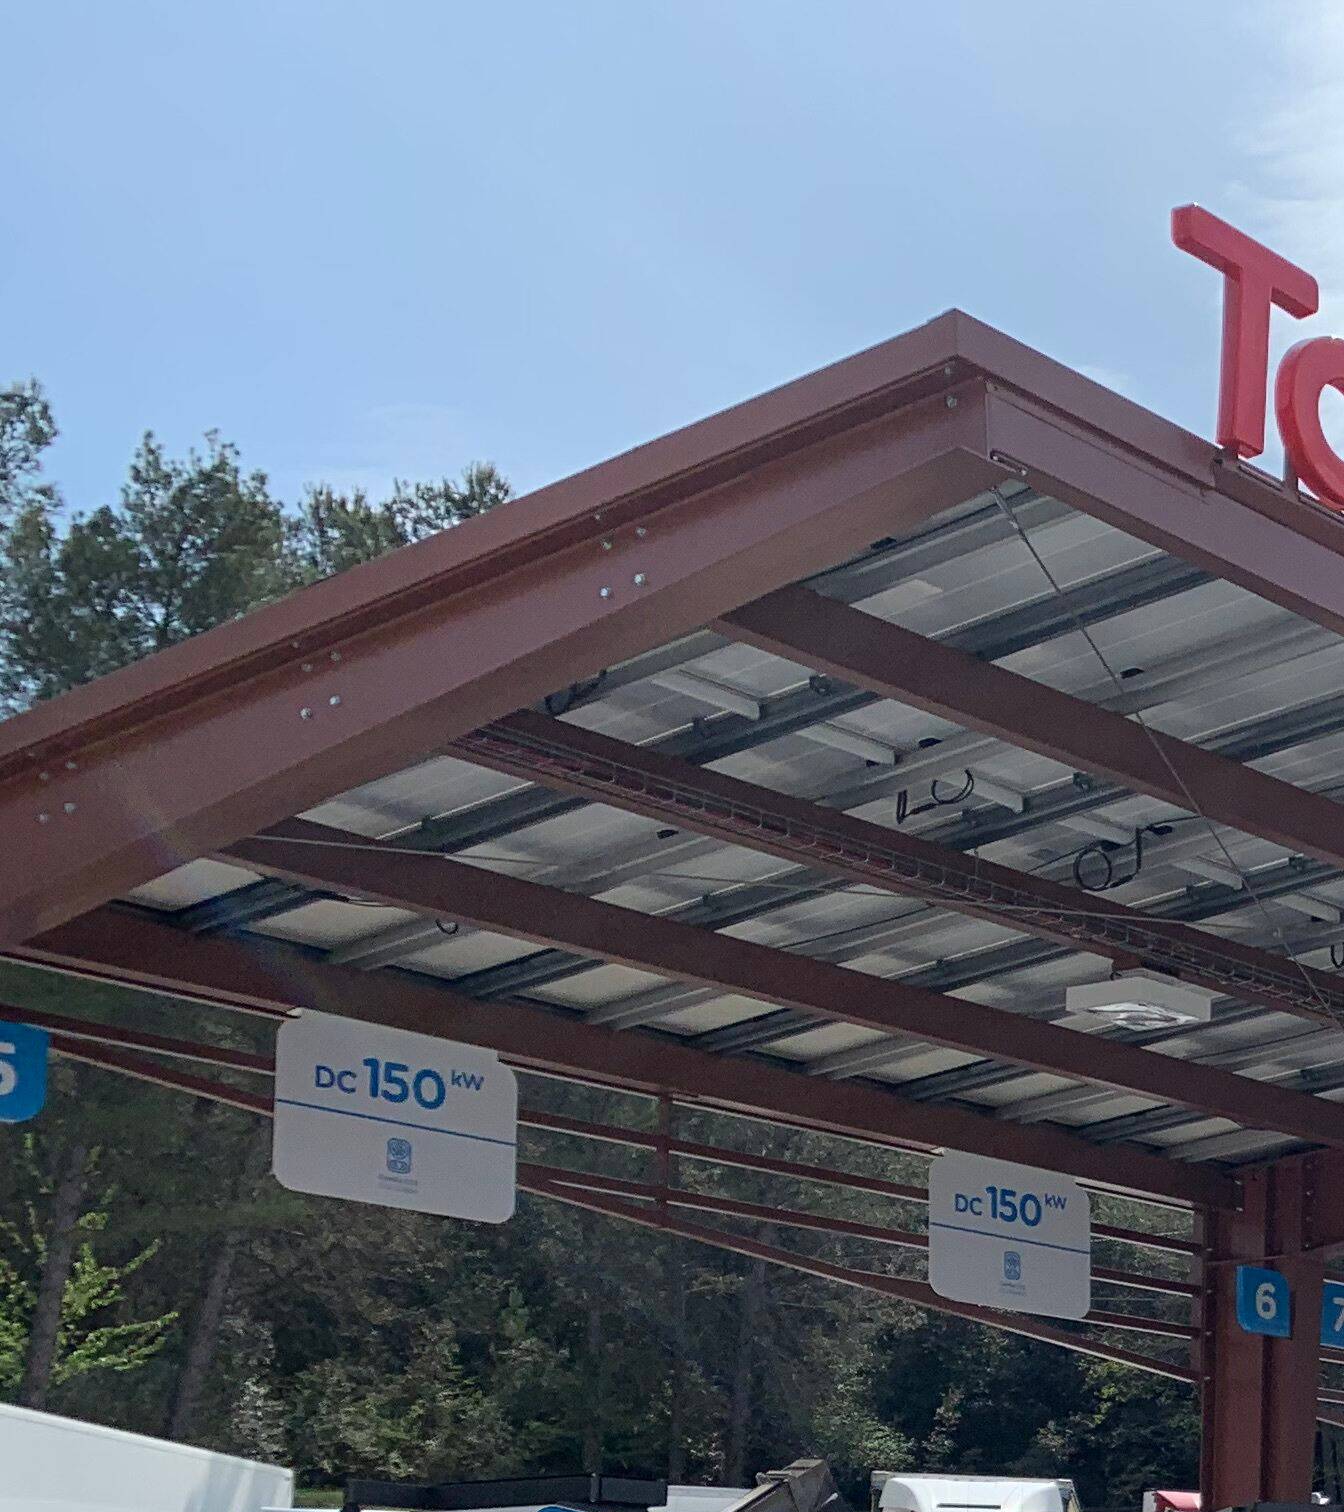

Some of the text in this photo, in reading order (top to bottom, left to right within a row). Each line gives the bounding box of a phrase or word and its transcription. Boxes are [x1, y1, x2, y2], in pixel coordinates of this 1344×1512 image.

[315, 1058, 485, 1110] DC 150 kW
[954, 1186, 1067, 1227] DC 150 kW
[1255, 1283, 1276, 1320] 6
